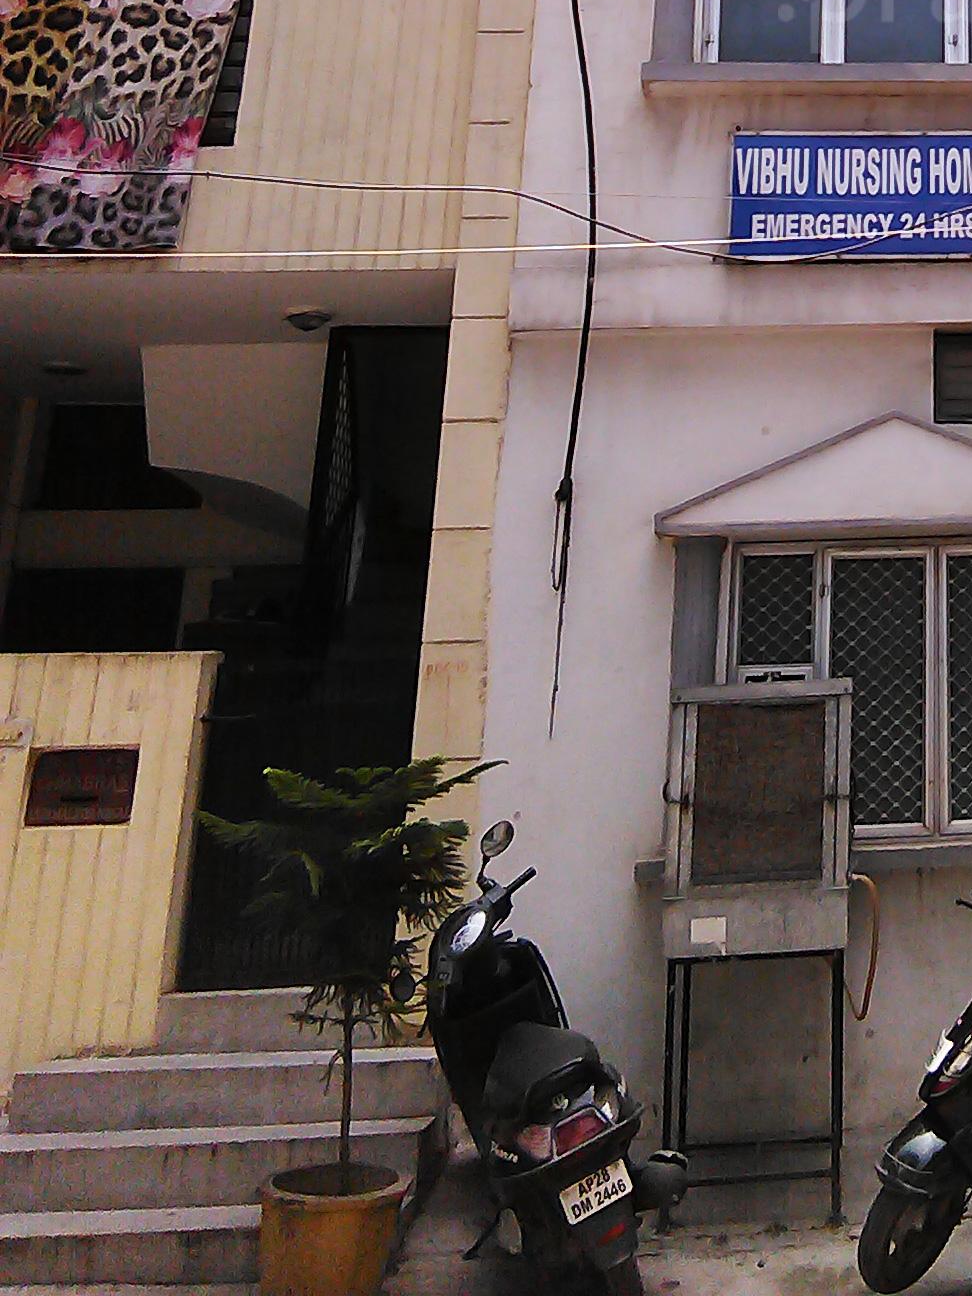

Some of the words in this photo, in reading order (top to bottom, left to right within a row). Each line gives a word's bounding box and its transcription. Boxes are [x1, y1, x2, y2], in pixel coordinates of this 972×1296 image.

[736, 147, 810, 195] VIBHU
[816, 147, 922, 196] NURSING
[751, 213, 894, 240] EMERGENCY
[900, 213, 927, 240] 24
[571, 1198, 593, 1220] DM
[595, 1178, 628, 1206] 2446
[577, 1168, 611, 1198] AP28
